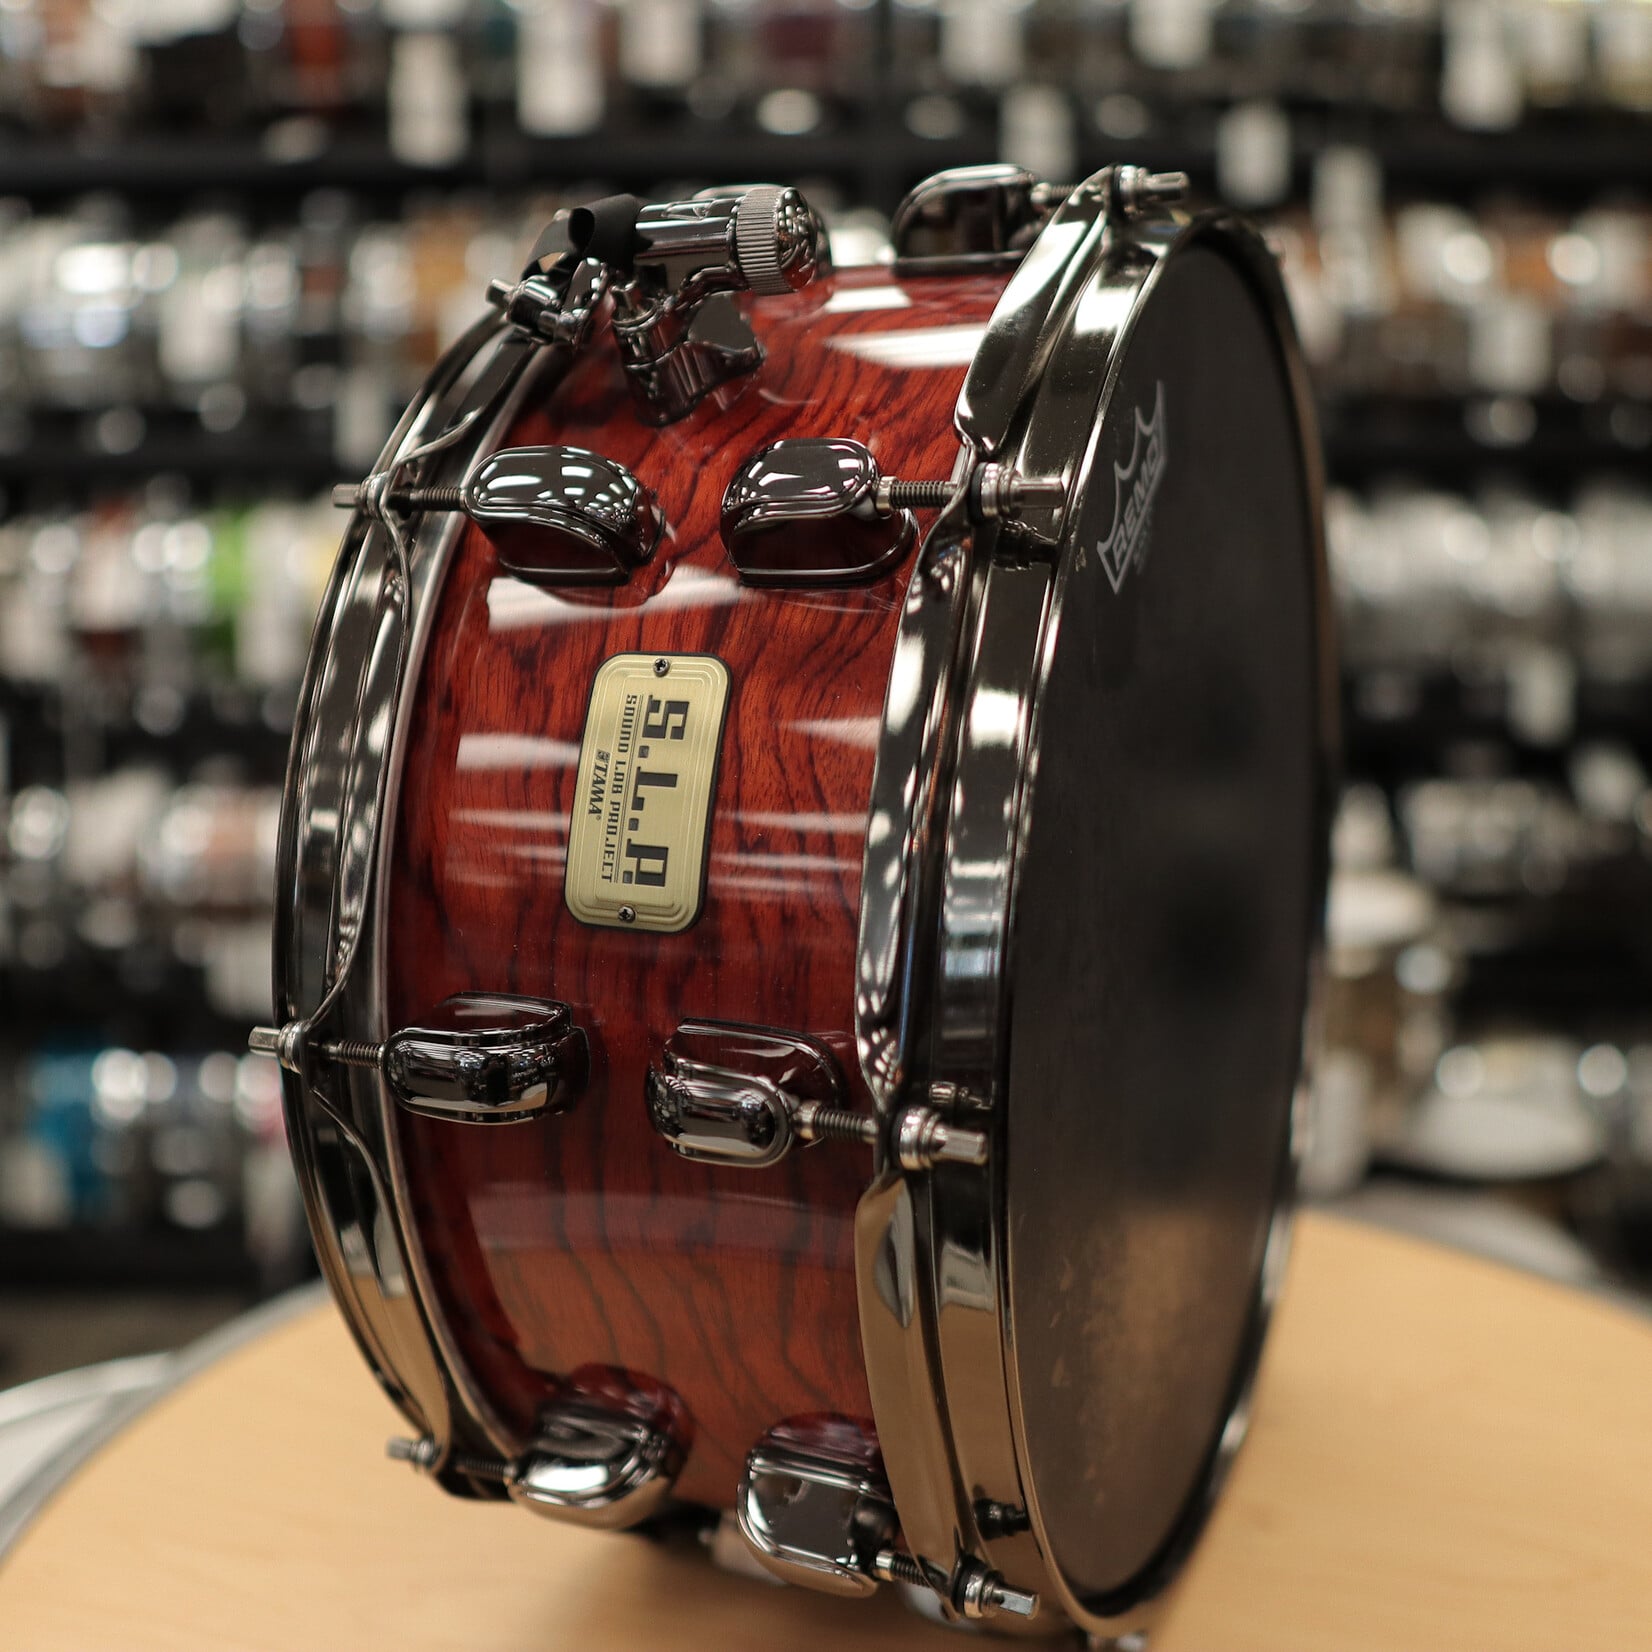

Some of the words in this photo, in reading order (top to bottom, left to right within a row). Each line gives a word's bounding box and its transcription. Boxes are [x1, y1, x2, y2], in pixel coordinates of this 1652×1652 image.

[1112, 436, 1160, 572] REMO
[617, 694, 638, 753] SOUND
[588, 762, 609, 815] TAMA
[609, 760, 627, 795] LAB
[622, 694, 690, 887] S.L.P.
[601, 800, 621, 883] PROJECT
